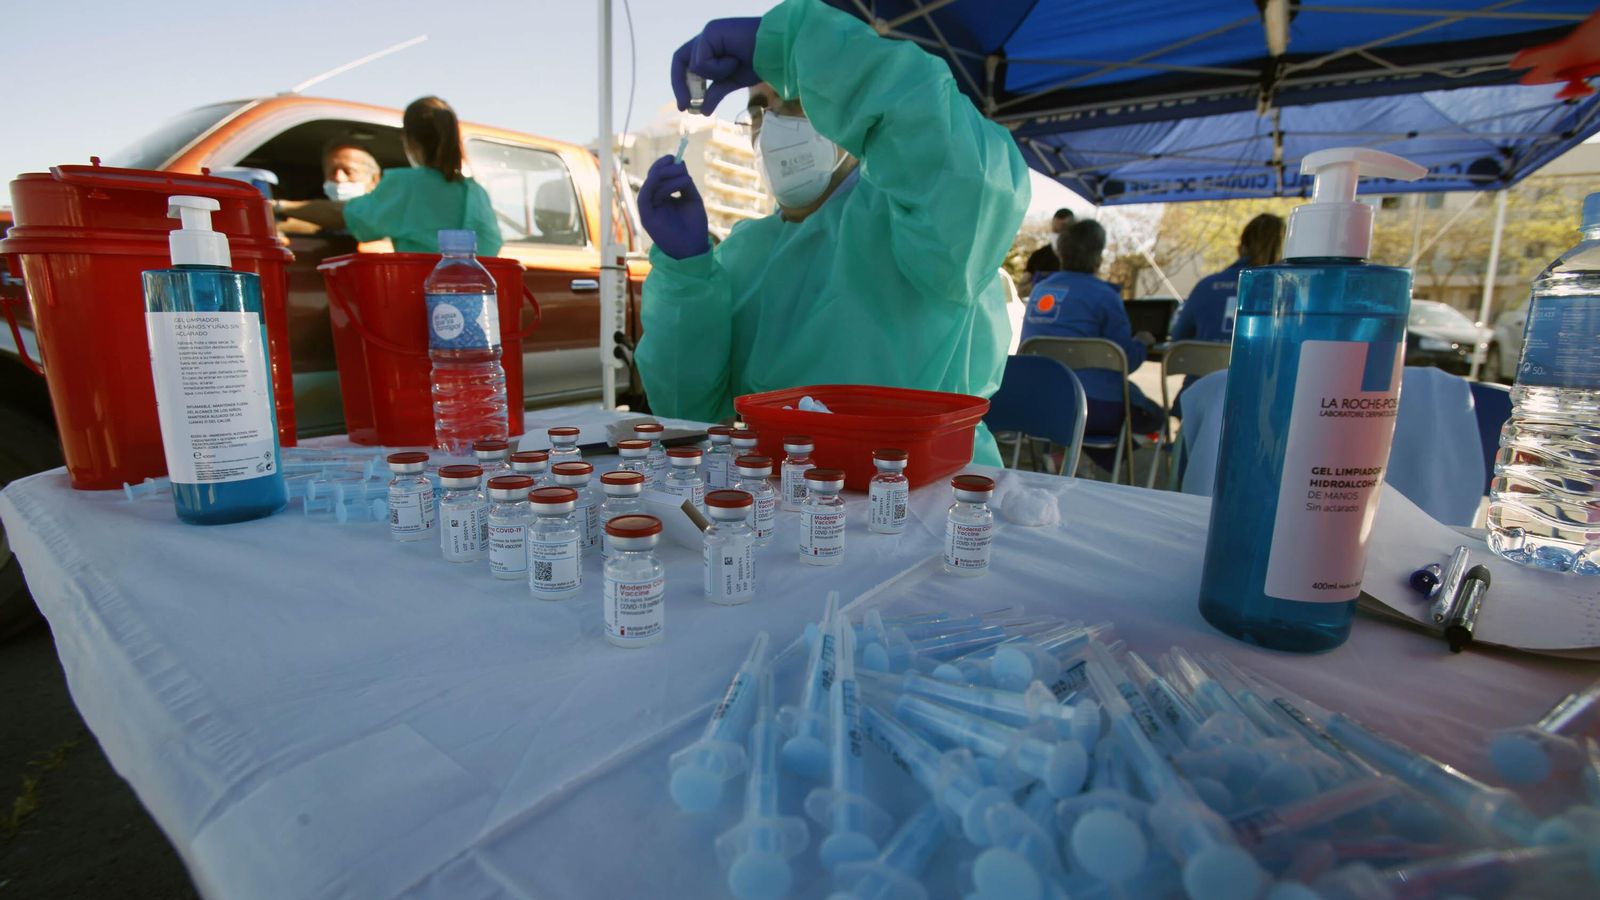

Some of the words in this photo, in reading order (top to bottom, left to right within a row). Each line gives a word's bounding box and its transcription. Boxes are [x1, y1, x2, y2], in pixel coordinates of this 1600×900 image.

[1320, 397, 1338, 409] LA
[1311, 467, 1332, 476] GEL
[1308, 490, 1321, 500] DE
[1324, 491, 1359, 500] MANOS
[1306, 503, 1322, 511] Sin
[1323, 504, 1359, 512] aclarado
[1312, 582, 1338, 590] 400ml
